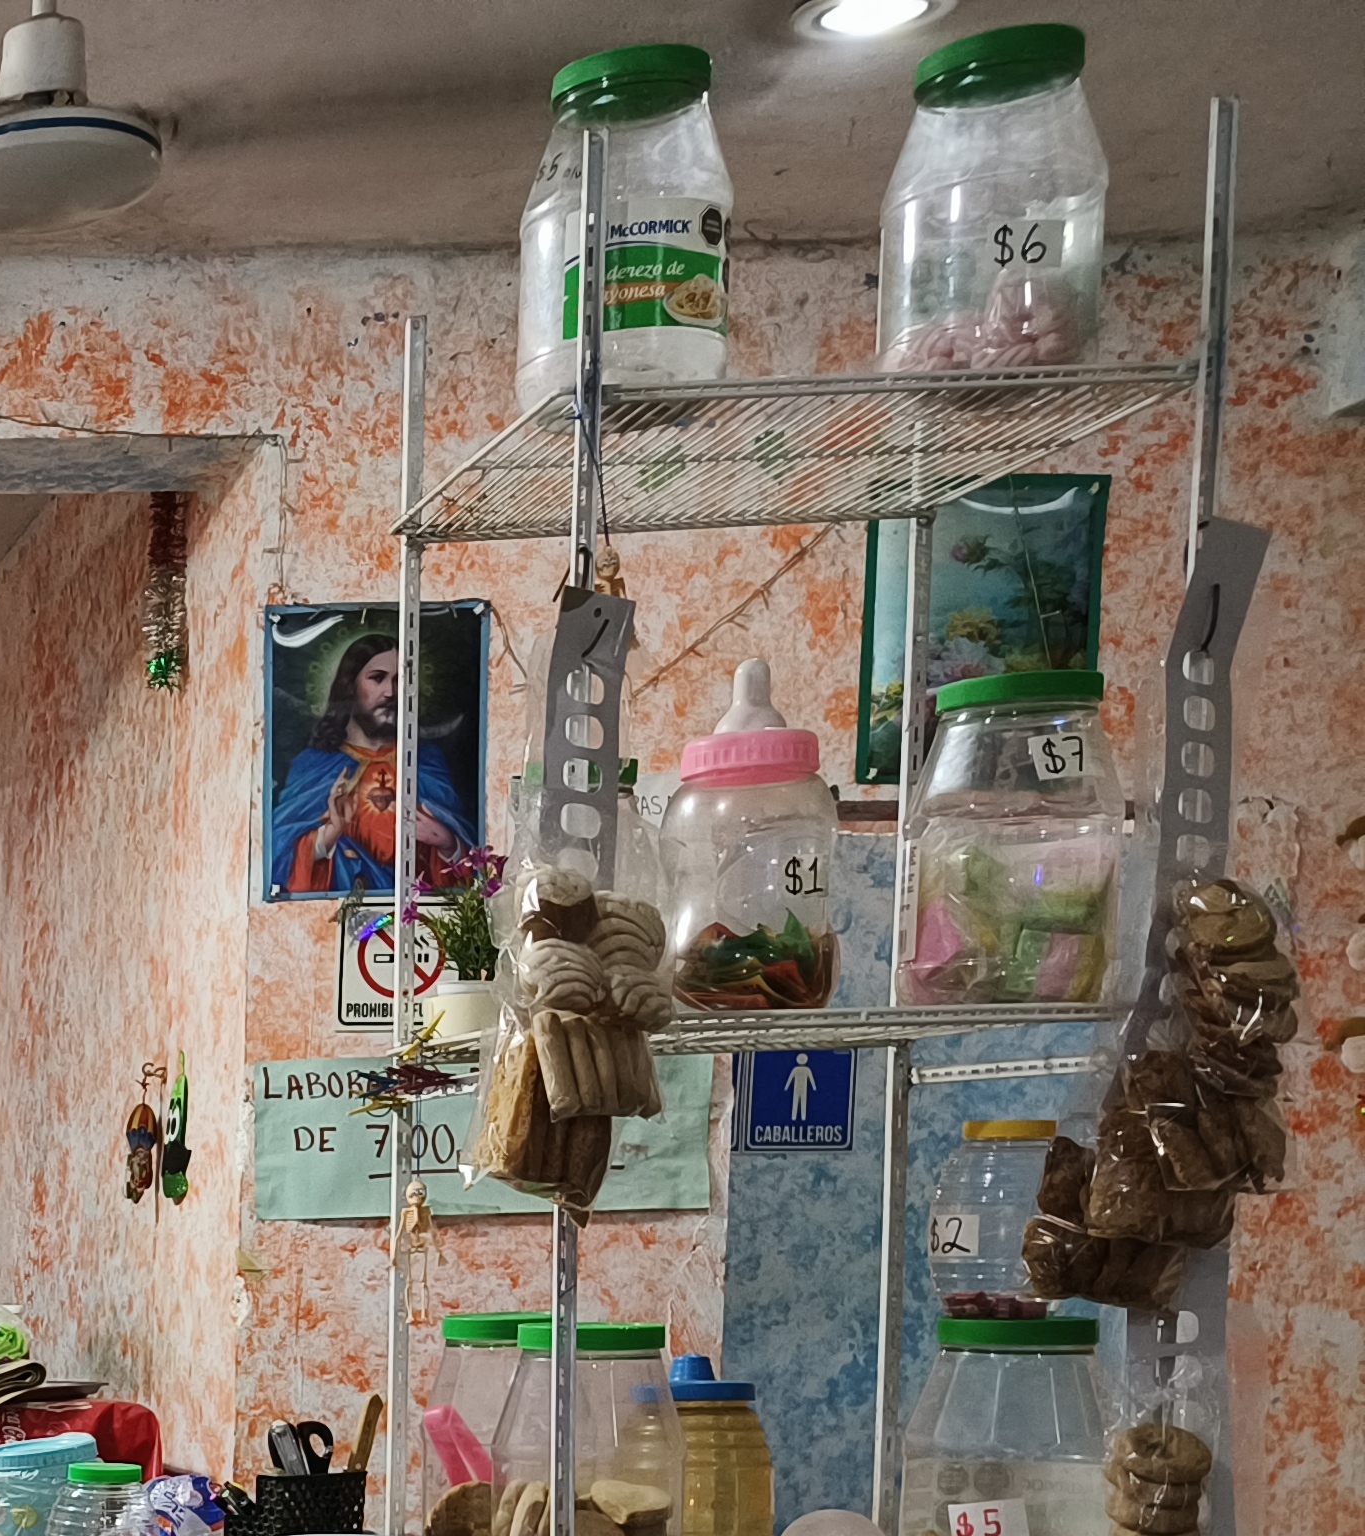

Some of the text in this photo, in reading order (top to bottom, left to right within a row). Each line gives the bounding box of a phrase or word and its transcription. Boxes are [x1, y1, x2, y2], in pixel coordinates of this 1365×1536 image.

[610, 219, 692, 239] McCORMICK
[994, 223, 1047, 268] $6
[606, 260, 686, 280] derezo de
[605, 283, 667, 306] yonesa
[1041, 734, 1085, 775] $7
[784, 856, 824, 896] $1
[345, 1002, 394, 1018] PROHIBI
[293, 1123, 456, 1165] DE 700
[754, 1125, 843, 1144] CABALLEROS
[930, 1217, 971, 1255] $2
